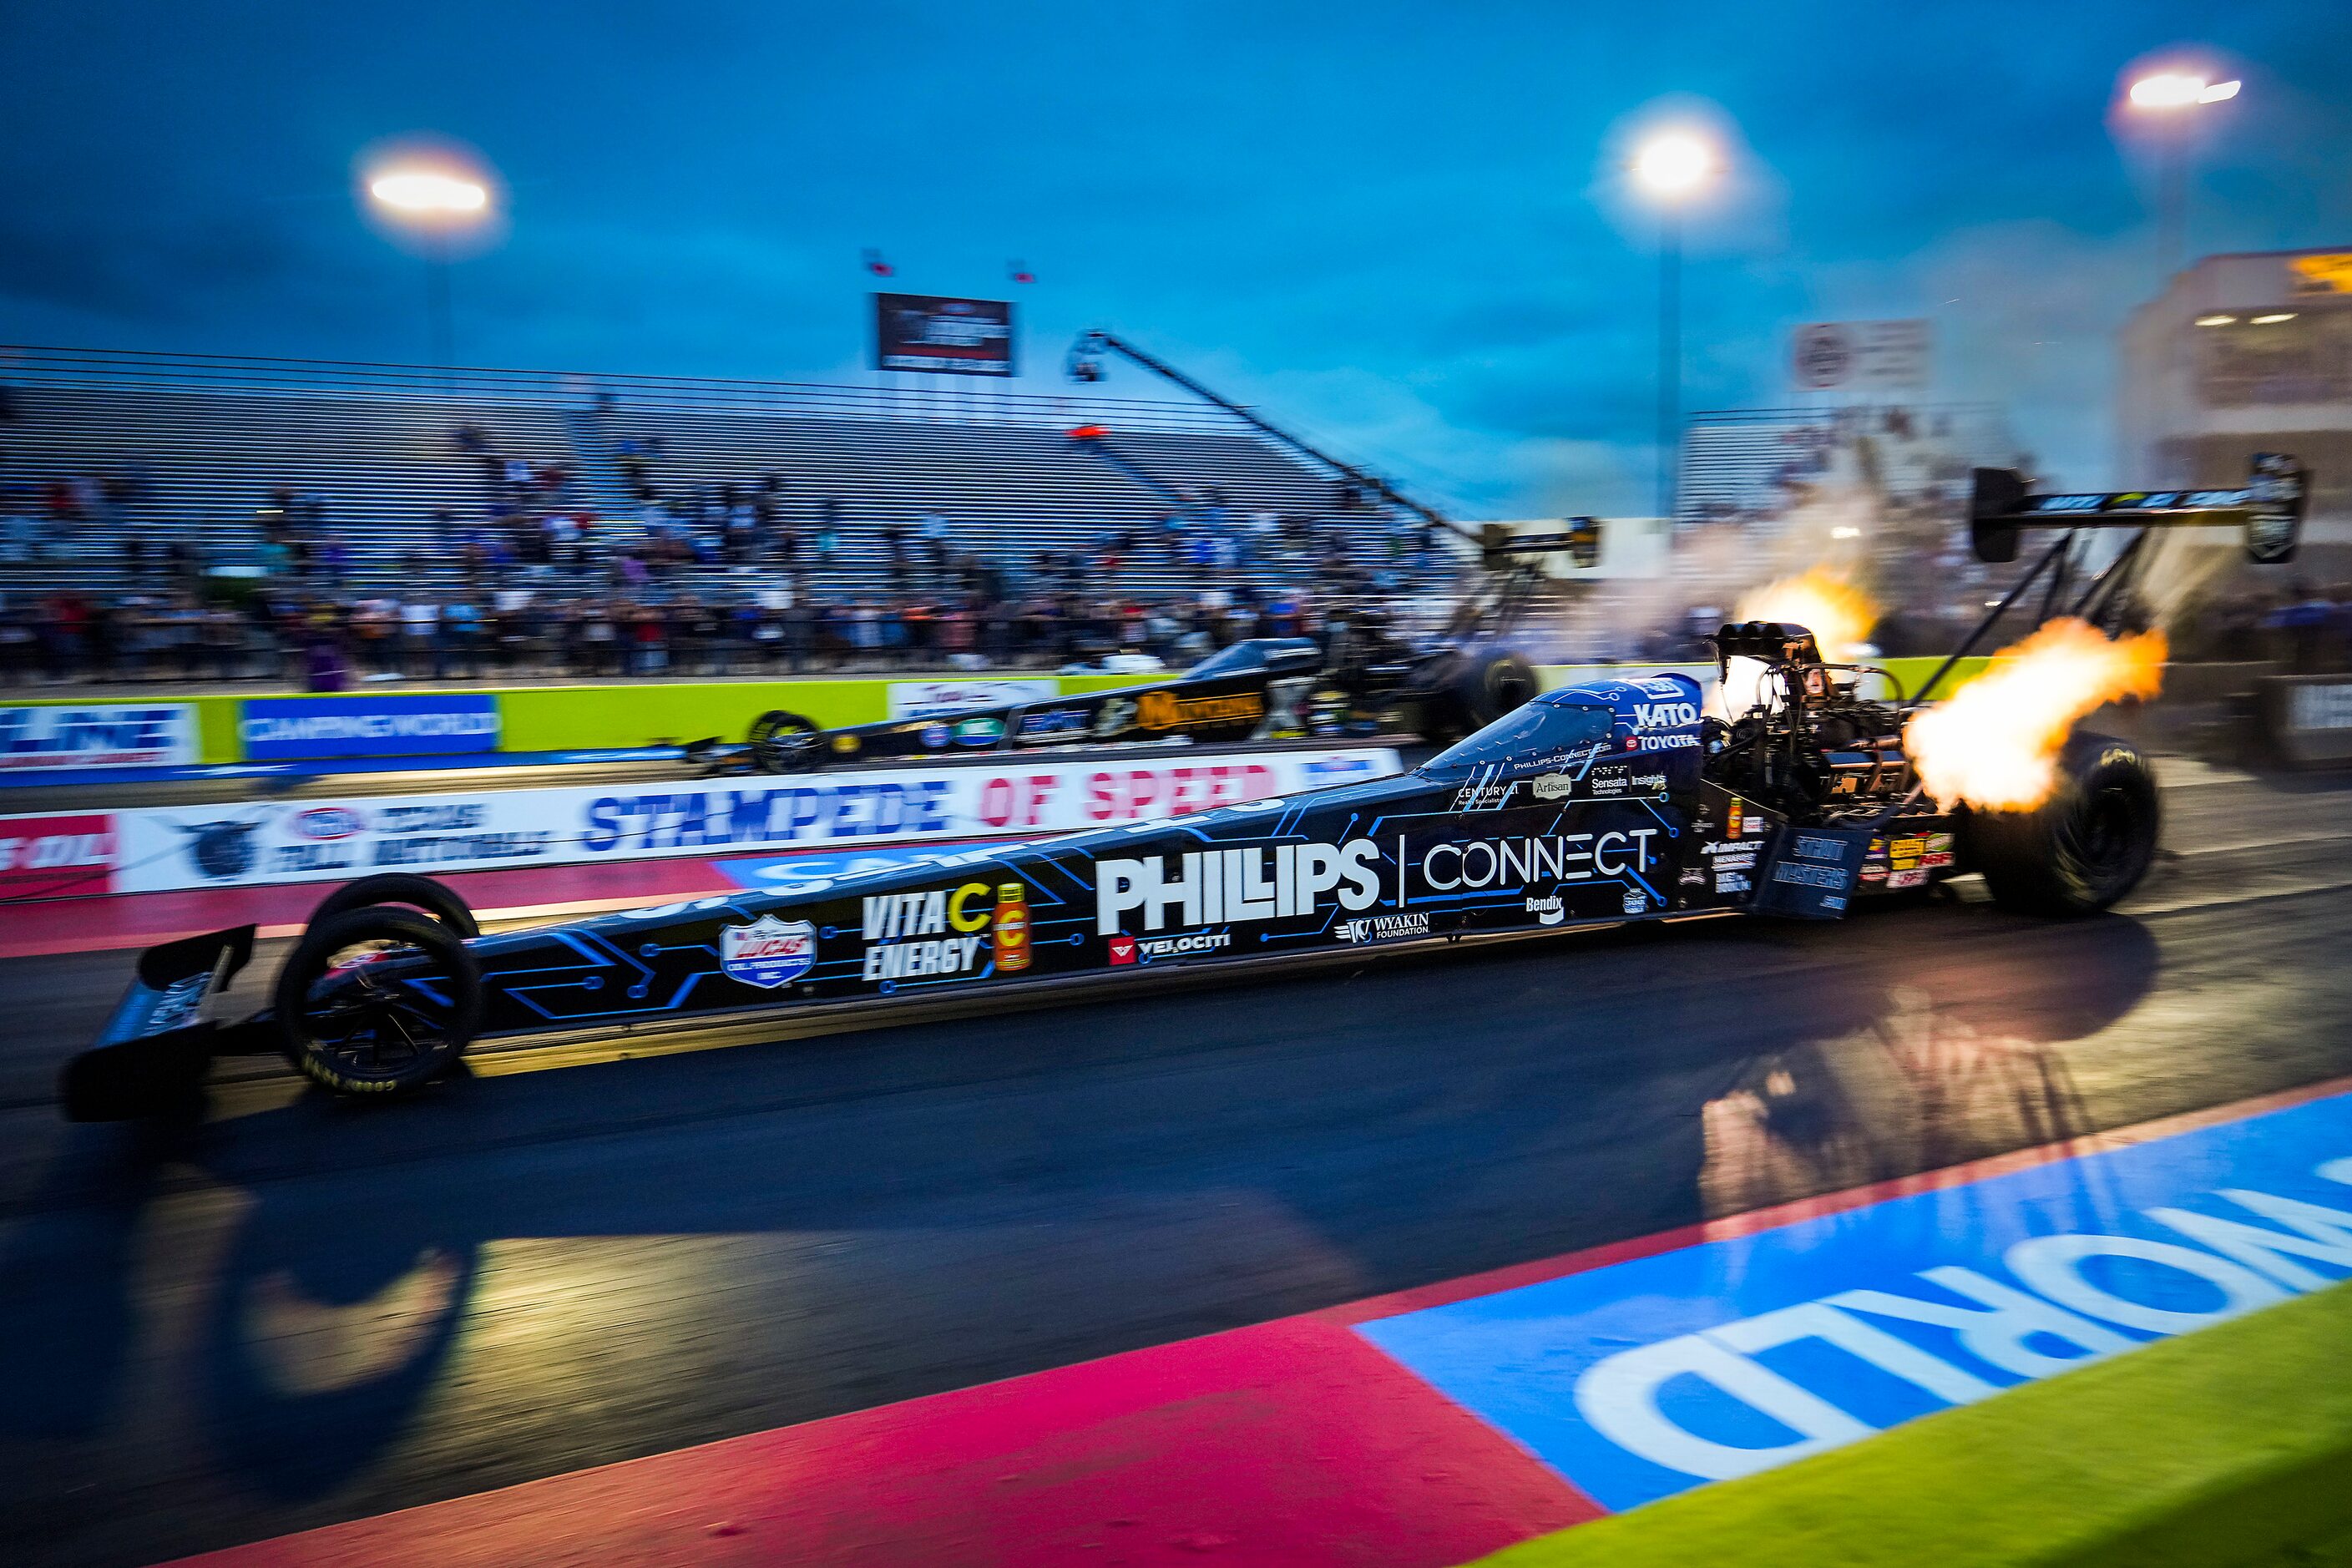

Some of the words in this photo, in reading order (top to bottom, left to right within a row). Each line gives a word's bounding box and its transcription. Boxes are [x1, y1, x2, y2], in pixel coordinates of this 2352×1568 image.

[1632, 702, 1697, 727] KATO
[1637, 735, 1701, 751] TOYOTA
[1458, 785, 1507, 798] CENTURY
[1536, 782, 1569, 793] Artisan
[1591, 777, 1627, 789] Sensata
[579, 780, 959, 852] STAMPEDE
[979, 774, 1060, 827] OF
[1088, 763, 1277, 821] SPEED
[1095, 837, 1380, 936] PHILLIPS
[1423, 828, 1658, 890] CONNECT
[1526, 896, 1563, 912] Bendix
[862, 890, 947, 941] VITA
[1374, 912, 1430, 930] WYAKIN
[1376, 927, 1429, 938] FOUNDATION
[1138, 934, 1231, 955] VELOCITI
[862, 935, 982, 982] ENERGY
